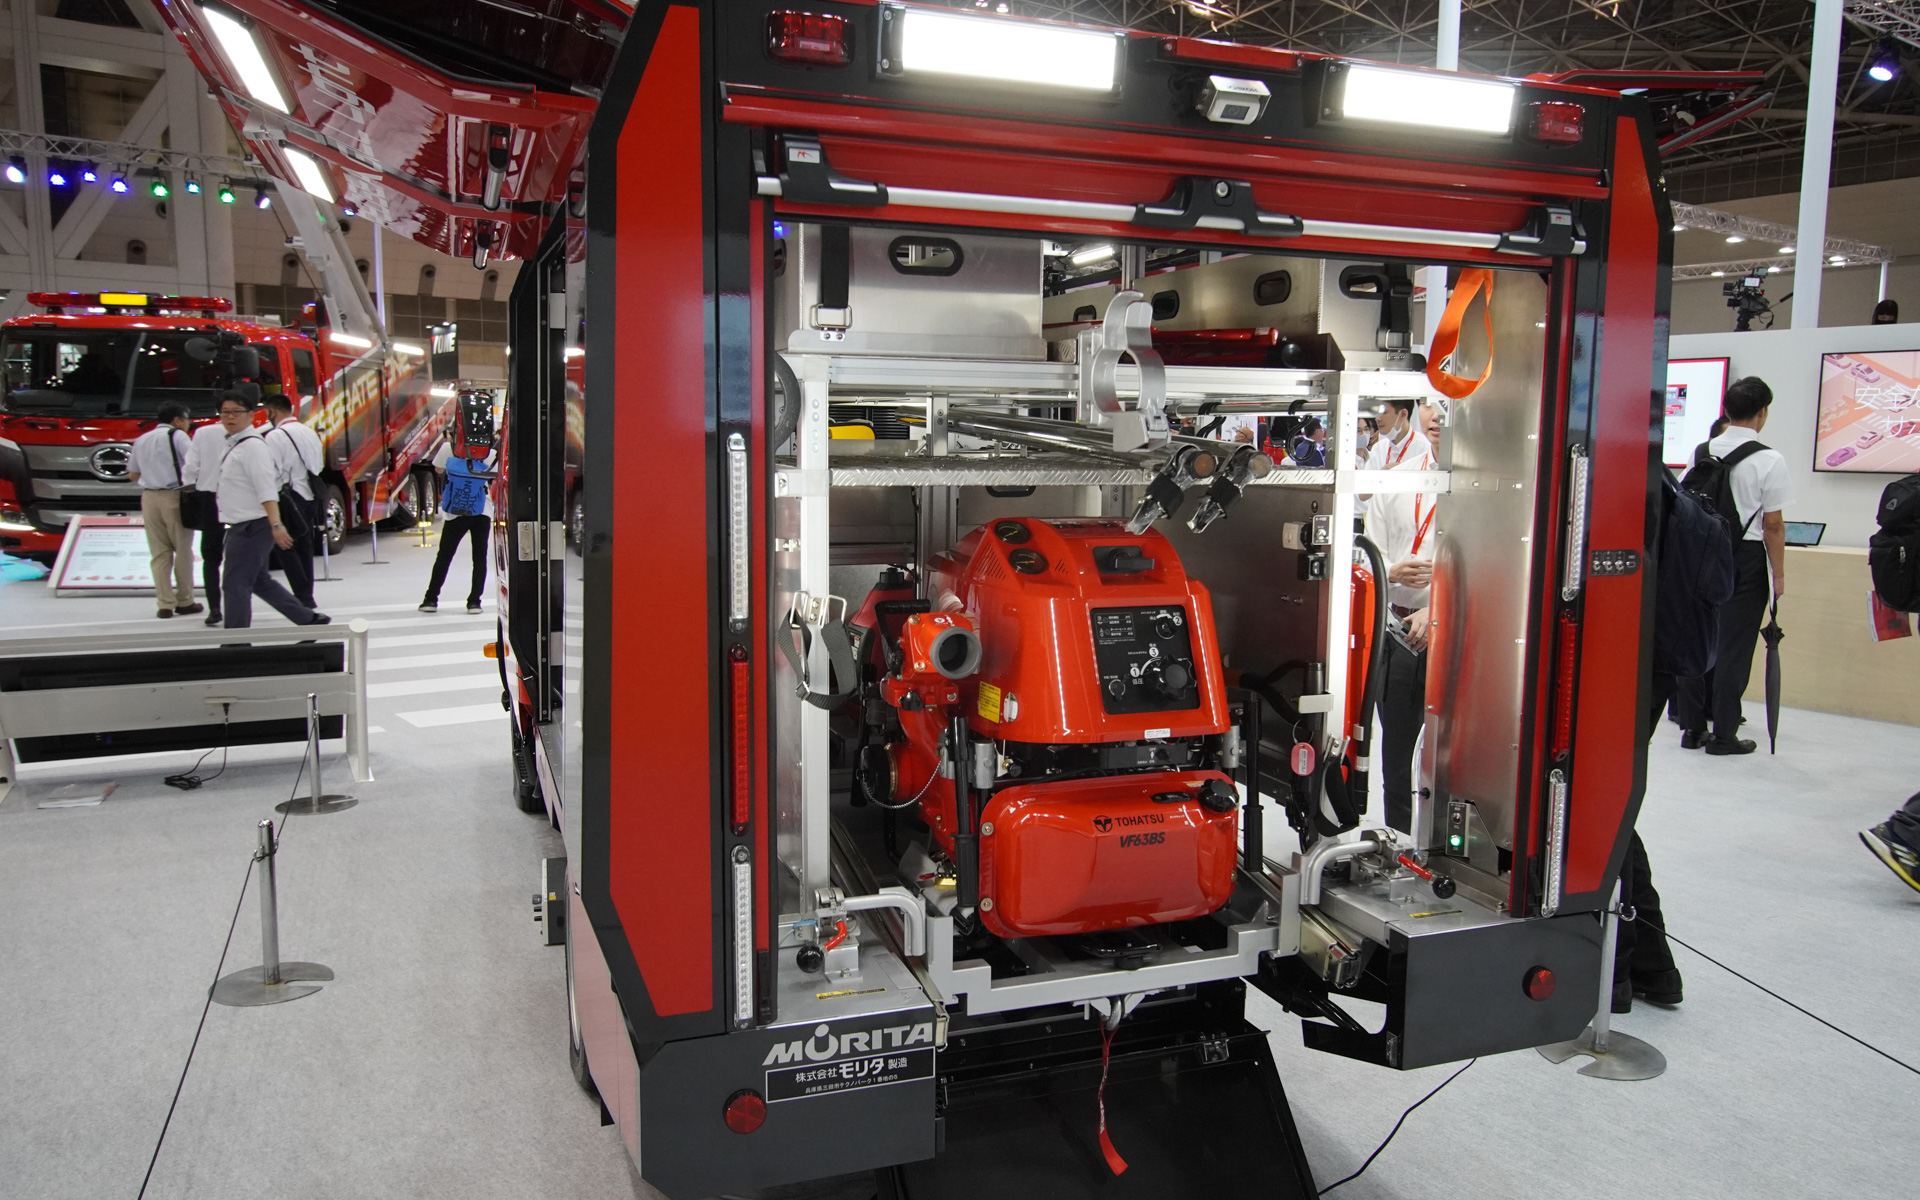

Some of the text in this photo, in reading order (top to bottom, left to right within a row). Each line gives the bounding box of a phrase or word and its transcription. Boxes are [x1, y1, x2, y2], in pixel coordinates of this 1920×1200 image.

[452, 487, 463, 507] FACE
[460, 480, 473, 509] NORTH
[1115, 813, 1165, 827] TOHATSU
[1119, 831, 1166, 848] VF63BS
[762, 1023, 933, 1066] MORITA
